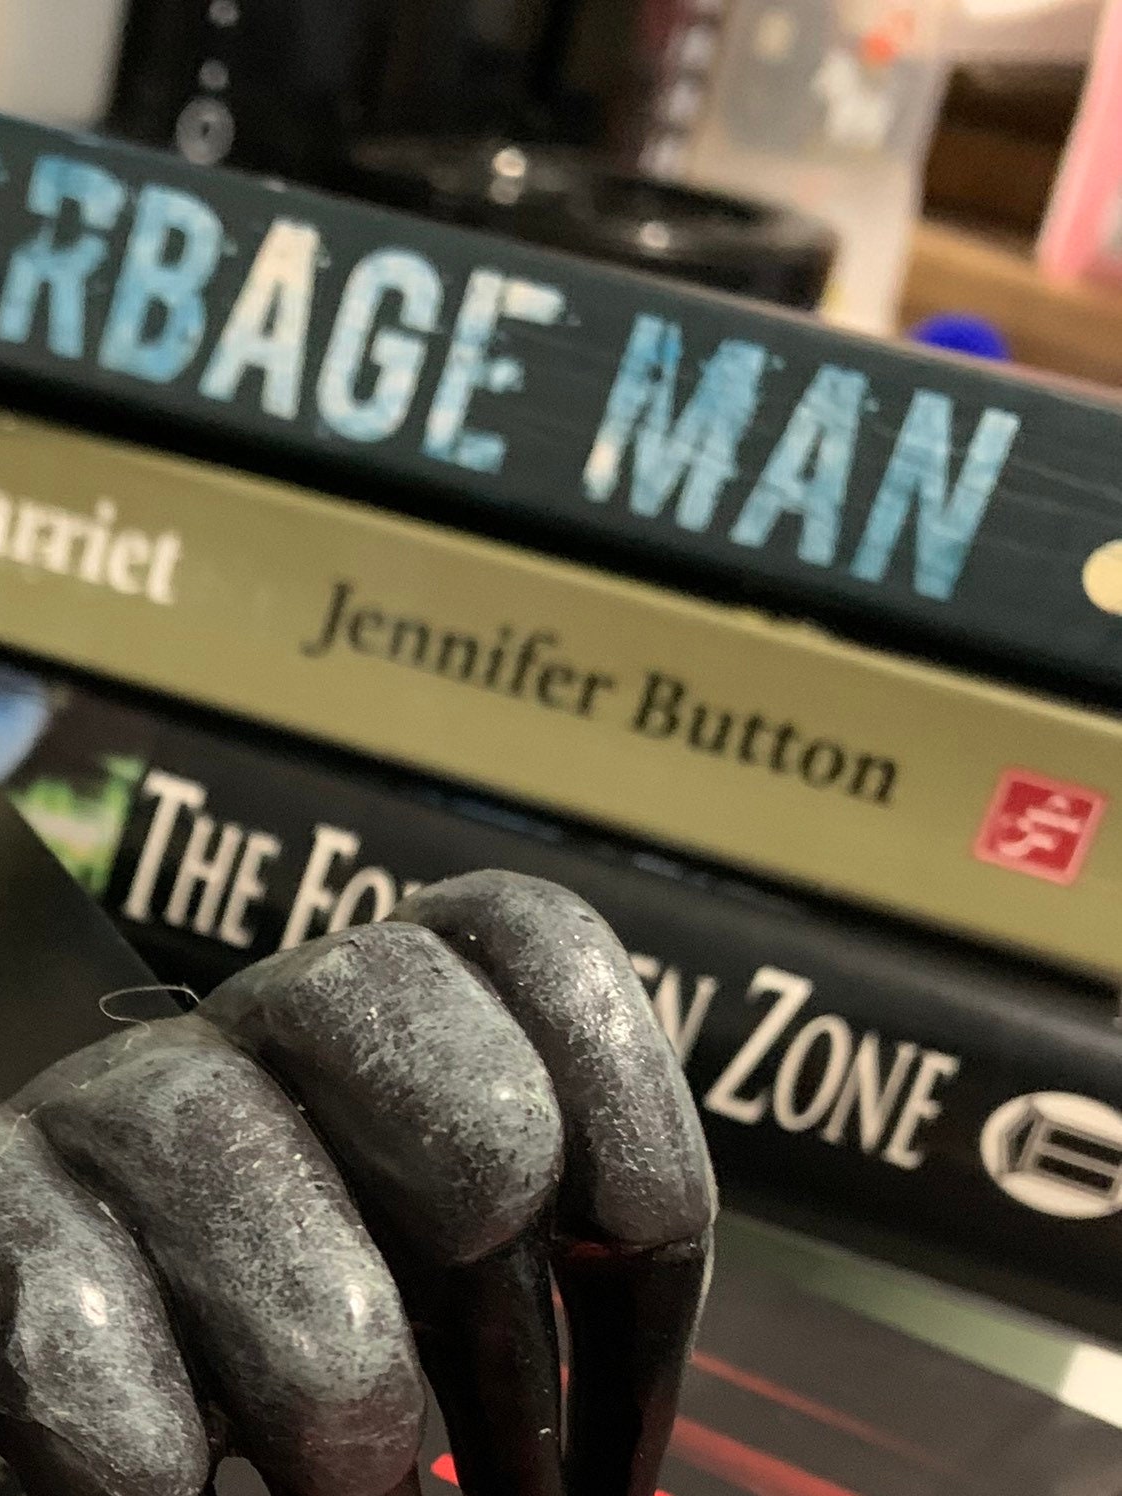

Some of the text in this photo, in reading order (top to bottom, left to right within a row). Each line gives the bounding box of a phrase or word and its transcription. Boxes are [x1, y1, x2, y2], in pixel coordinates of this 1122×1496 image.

[583, 312, 1022, 601] MAN
[299, 578, 614, 719] Jennifer
[632, 667, 901, 807] Button
[122, 768, 281, 949] THE
[704, 964, 962, 1171] ZONE
